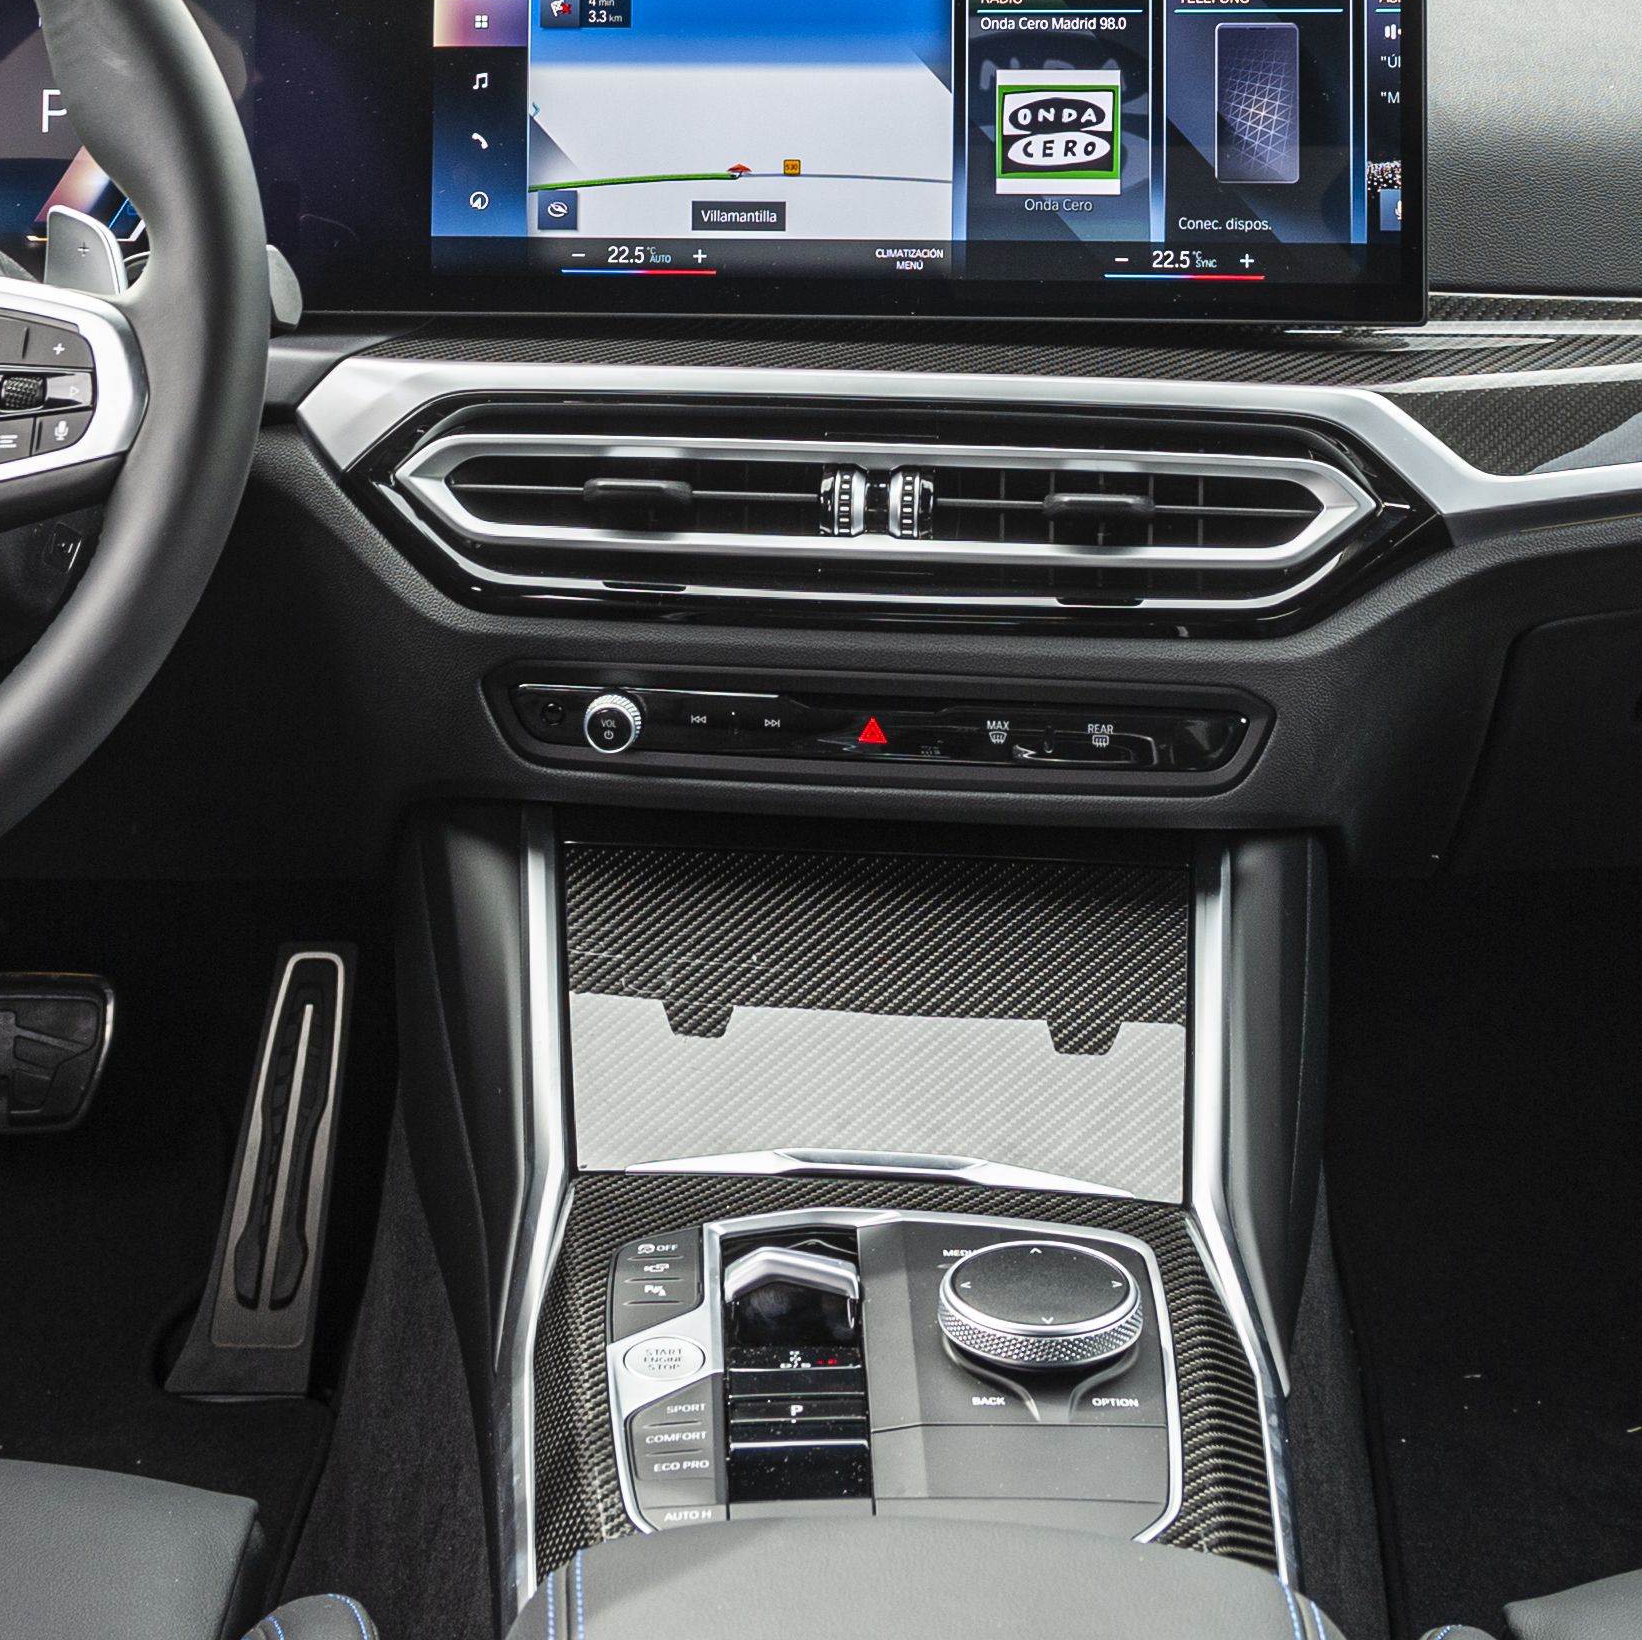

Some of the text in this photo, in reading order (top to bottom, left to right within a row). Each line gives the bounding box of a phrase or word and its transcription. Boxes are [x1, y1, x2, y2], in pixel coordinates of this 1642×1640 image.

[588, 10, 623, 23] 3.3 km
[980, 16, 1127, 30] Onda Cero Madrid 98.0
[1017, 105, 1098, 126] ONDA
[1022, 138, 1097, 158] CERO
[1024, 198, 1093, 212] Onda Cero
[700, 208, 778, 224] Villamantilla
[1178, 216, 1273, 233] Conec. dispos.
[607, 246, 645, 264] 22.5
[875, 246, 944, 259] CLIMATIZACIÓN
[649, 254, 672, 264] AUTO
[896, 258, 924, 271] MENÚ
[1152, 250, 1191, 269] 22.5
[1195, 258, 1218, 269] SYNC
[600, 719, 617, 729] VOL
[986, 720, 1010, 731] MAX
[1087, 724, 1114, 734] REAR
[656, 1243, 678, 1252] OFF
[645, 1348, 683, 1356] START
[643, 1356, 683, 1364] ENGINE
[648, 1363, 682, 1371] STOP
[971, 1396, 1006, 1407] BACK
[1091, 1397, 1139, 1408] OPTION
[666, 1402, 706, 1414] SPORT
[790, 1404, 804, 1416] P
[645, 1430, 707, 1444] COMFORT
[653, 1459, 710, 1472] ECO PRO
[663, 1510, 712, 1521] AUTO H
